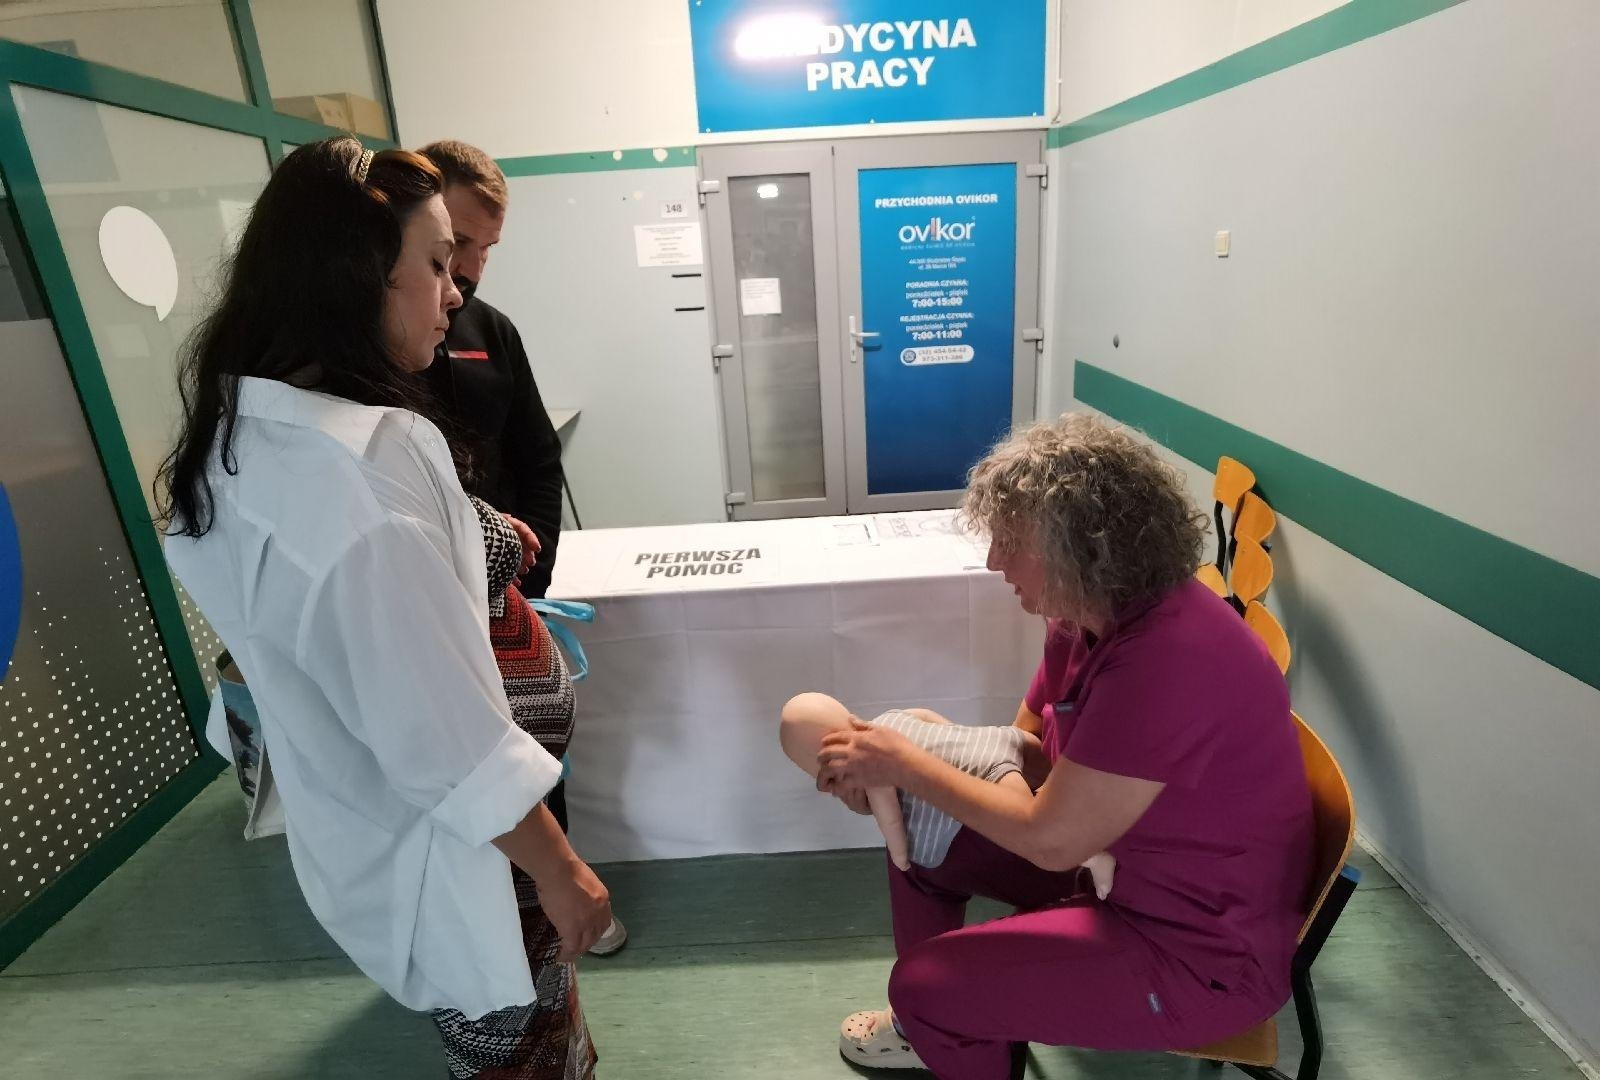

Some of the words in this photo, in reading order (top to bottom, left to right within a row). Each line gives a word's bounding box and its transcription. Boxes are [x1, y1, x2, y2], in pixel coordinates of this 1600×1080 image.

[768, 18, 977, 55] DYCYNA
[806, 56, 935, 91] PRACY
[875, 195, 954, 208] PRZYCHODNIA
[956, 193, 998, 204] OVIKOR
[912, 330, 963, 341] 7:00-11:00
[634, 548, 761, 565] PIERWSZA
[646, 562, 743, 578] POMOC
